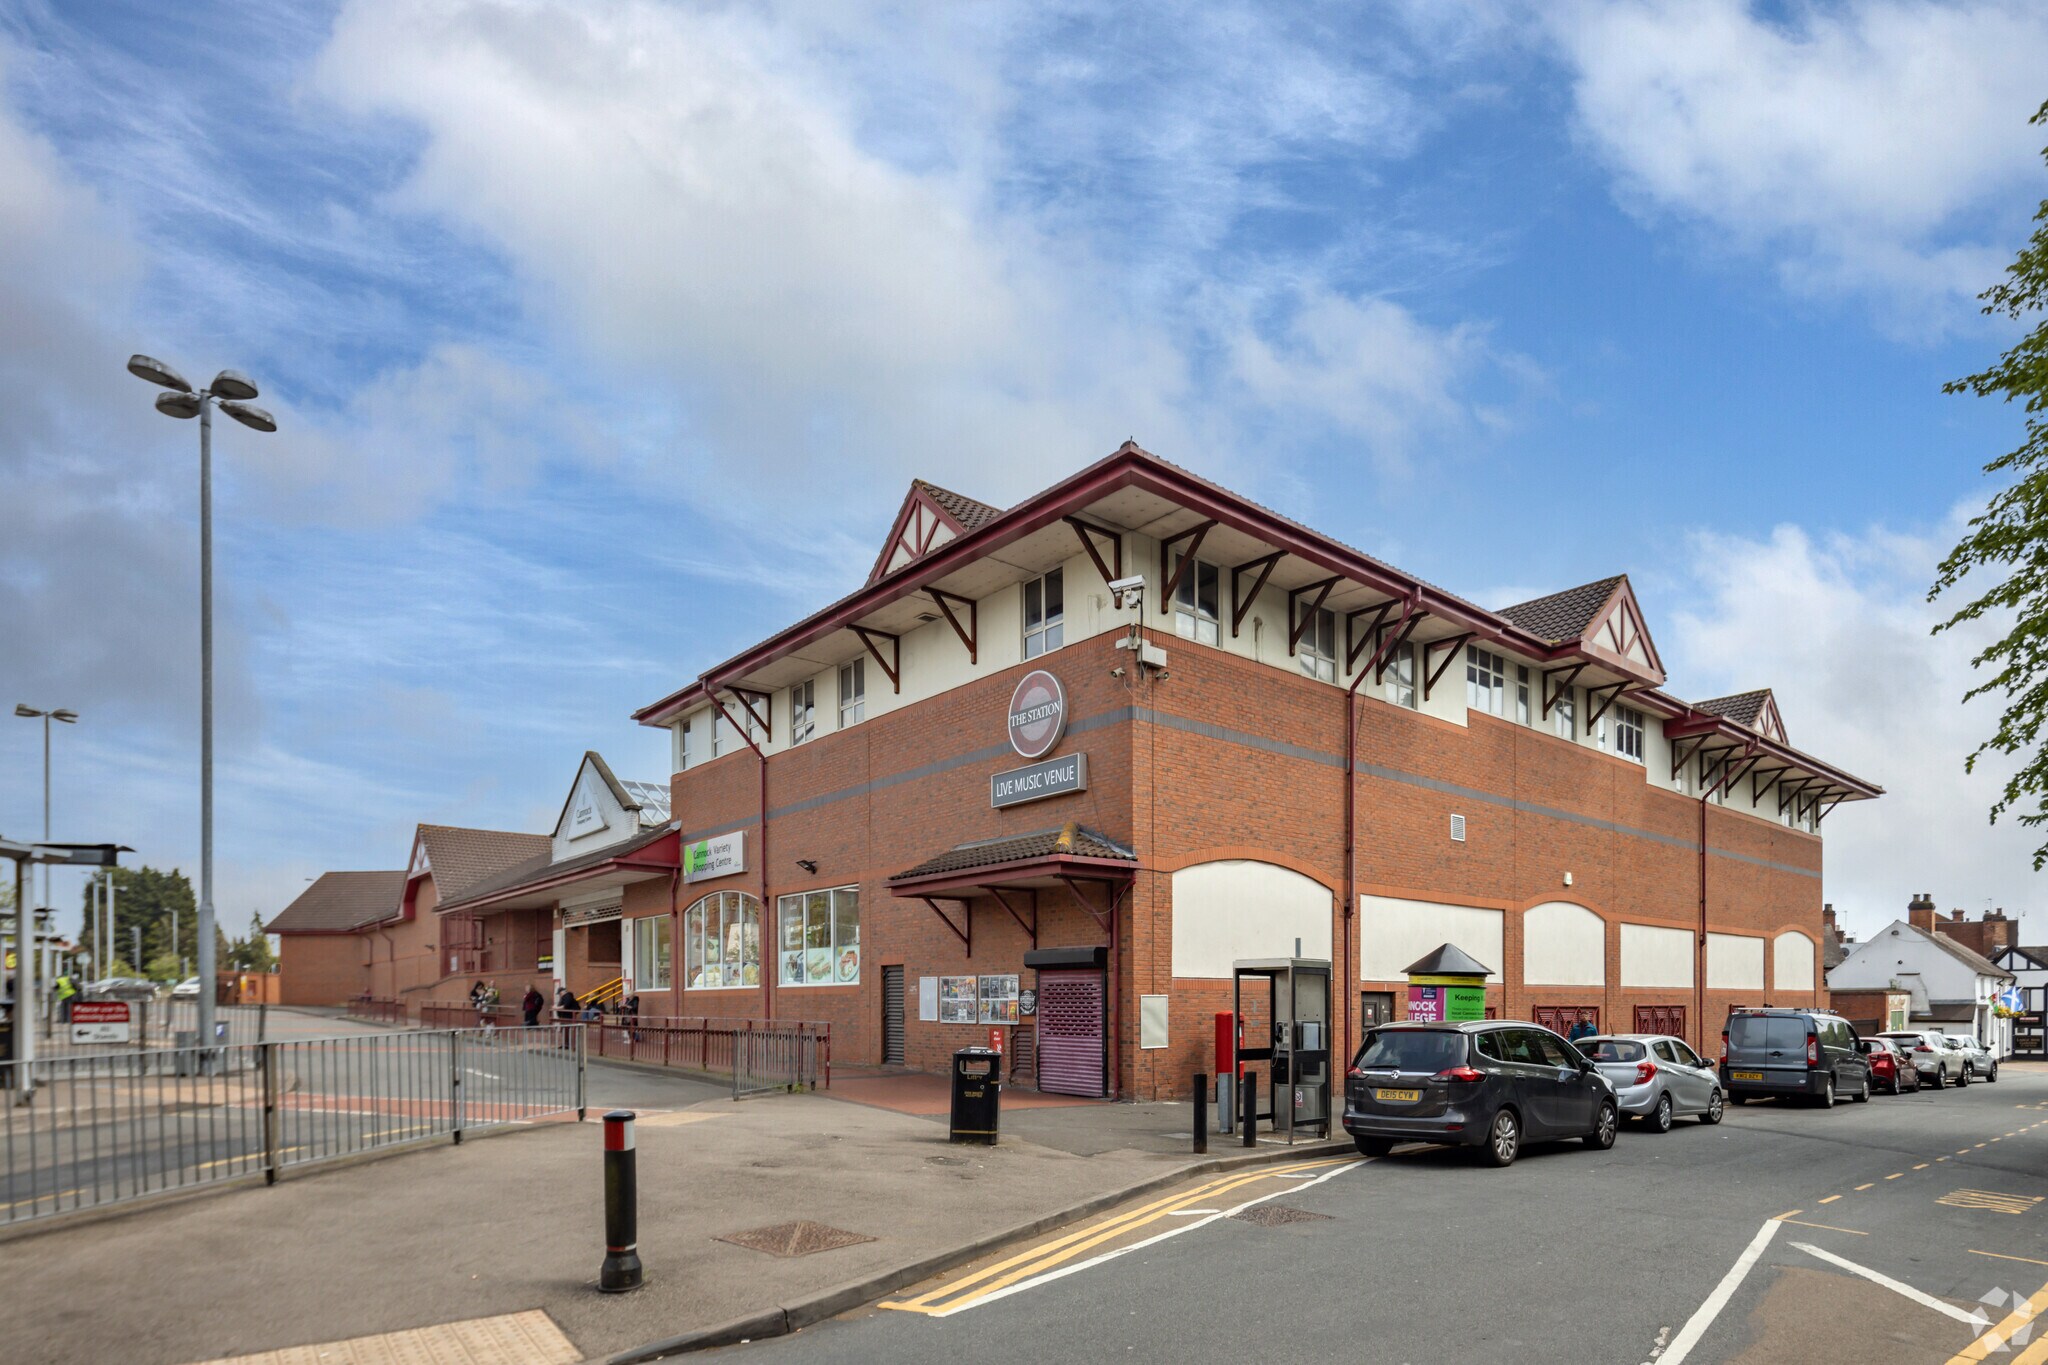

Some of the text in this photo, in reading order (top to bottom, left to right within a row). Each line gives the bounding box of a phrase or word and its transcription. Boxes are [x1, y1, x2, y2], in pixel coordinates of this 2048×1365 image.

[1011, 700, 1060, 727] THE STATION
[996, 765, 1075, 797] LIVE MUSIC VENUE
[693, 843, 731, 860] Cannock Variety
[693, 857, 732, 873] Shopping Centre
[1455, 994, 1480, 1002] Keeping
[1398, 1091, 1414, 1099] CYW
